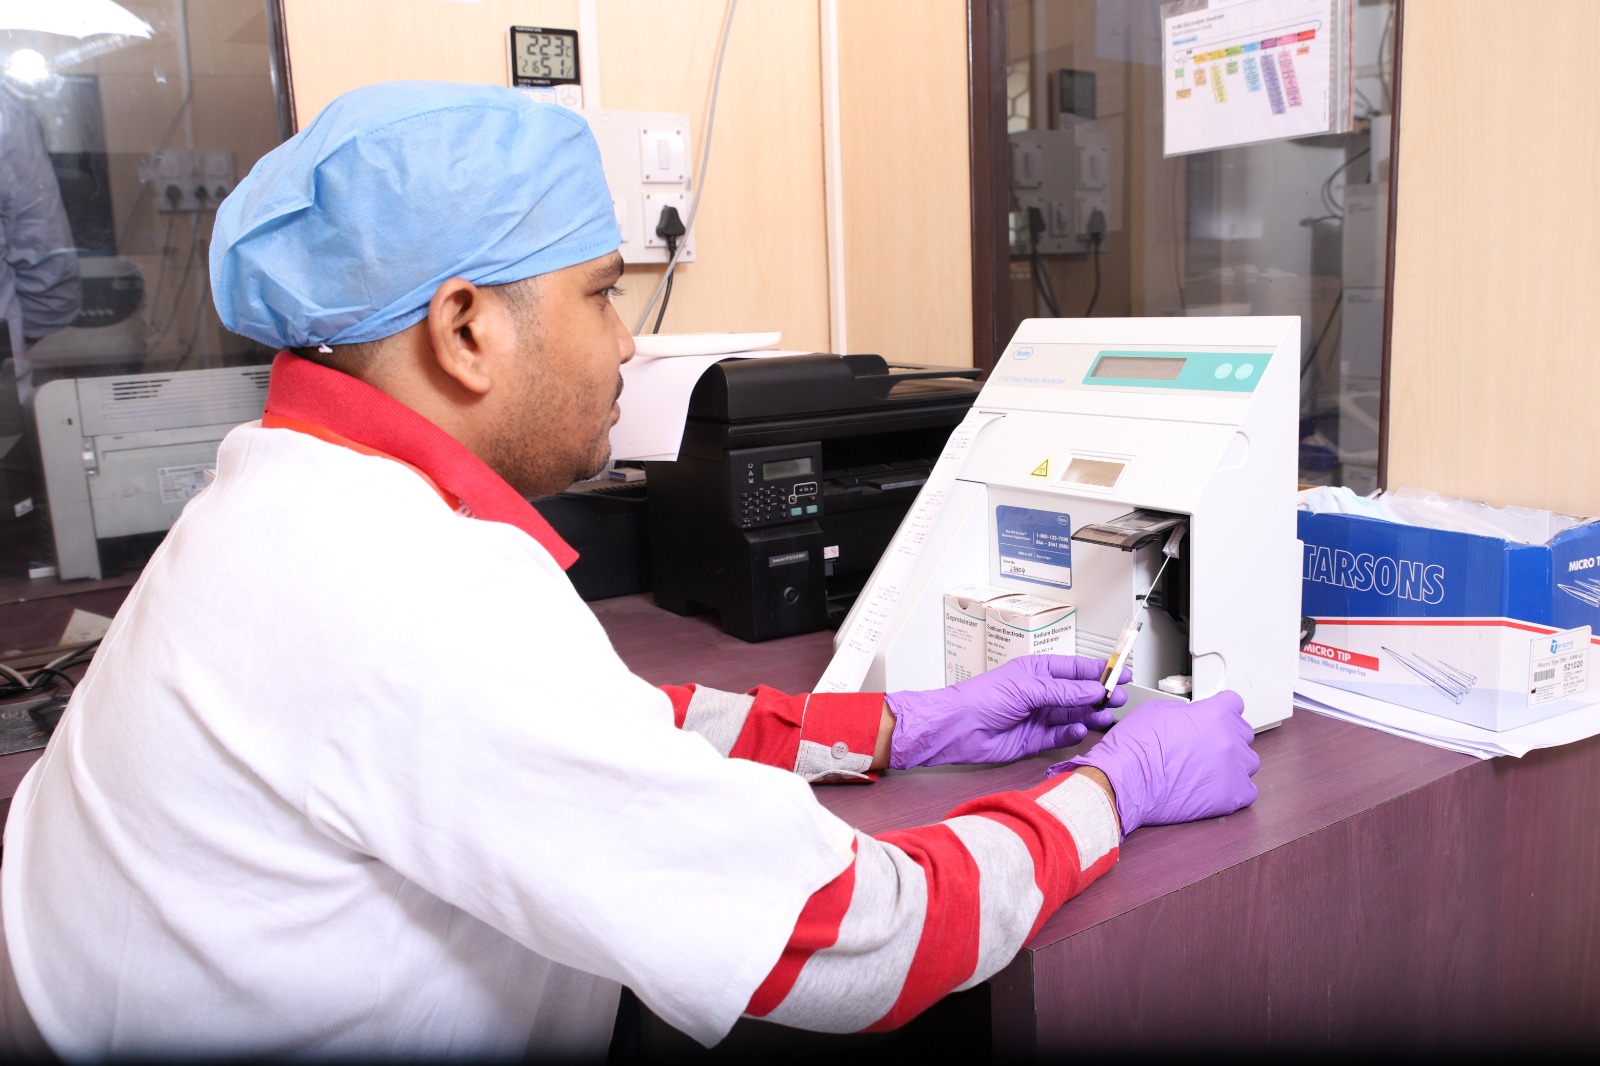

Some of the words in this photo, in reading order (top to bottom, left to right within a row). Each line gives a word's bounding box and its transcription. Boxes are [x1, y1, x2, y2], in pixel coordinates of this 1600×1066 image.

[1569, 557, 1595, 572] MICRO
[1302, 543, 1445, 604] TARSONS
[946, 613, 978, 628] Deproteinizer
[987, 623, 1001, 633] Sodium
[1002, 628, 1025, 639] Electrode
[987, 631, 1011, 643] Conditioner
[1034, 630, 1051, 640] Sodium
[1051, 625, 1072, 635] Electrode
[1034, 636, 1060, 646] Conditioner
[1304, 644, 1335, 658] MICRO
[1337, 650, 1351, 662] TIP
[1340, 666, 1356, 675] pyrogen
[1564, 660, 1583, 671] 521020
